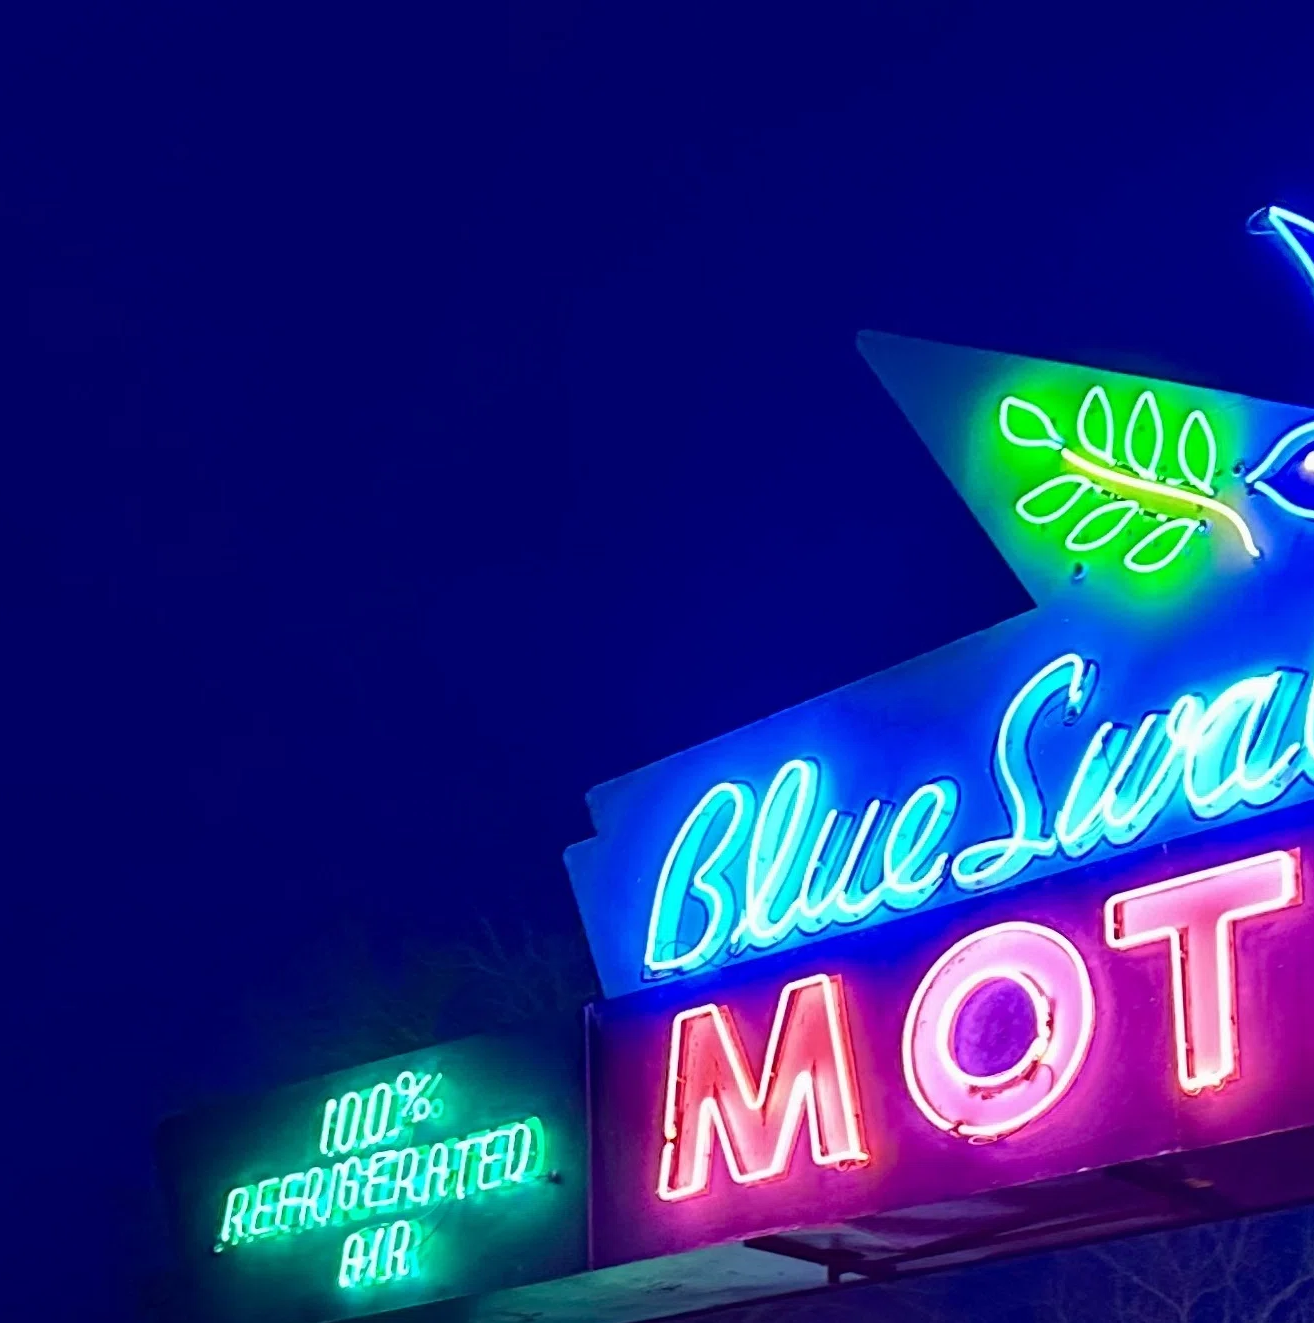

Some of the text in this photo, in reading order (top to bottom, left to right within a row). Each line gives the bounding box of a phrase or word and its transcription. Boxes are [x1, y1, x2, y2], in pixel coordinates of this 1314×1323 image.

[643, 757, 951, 979] Blue
[320, 1070, 440, 1156] 100%
[219, 1119, 541, 1243] REFRIGERATED
[338, 1219, 419, 1289] AIR
